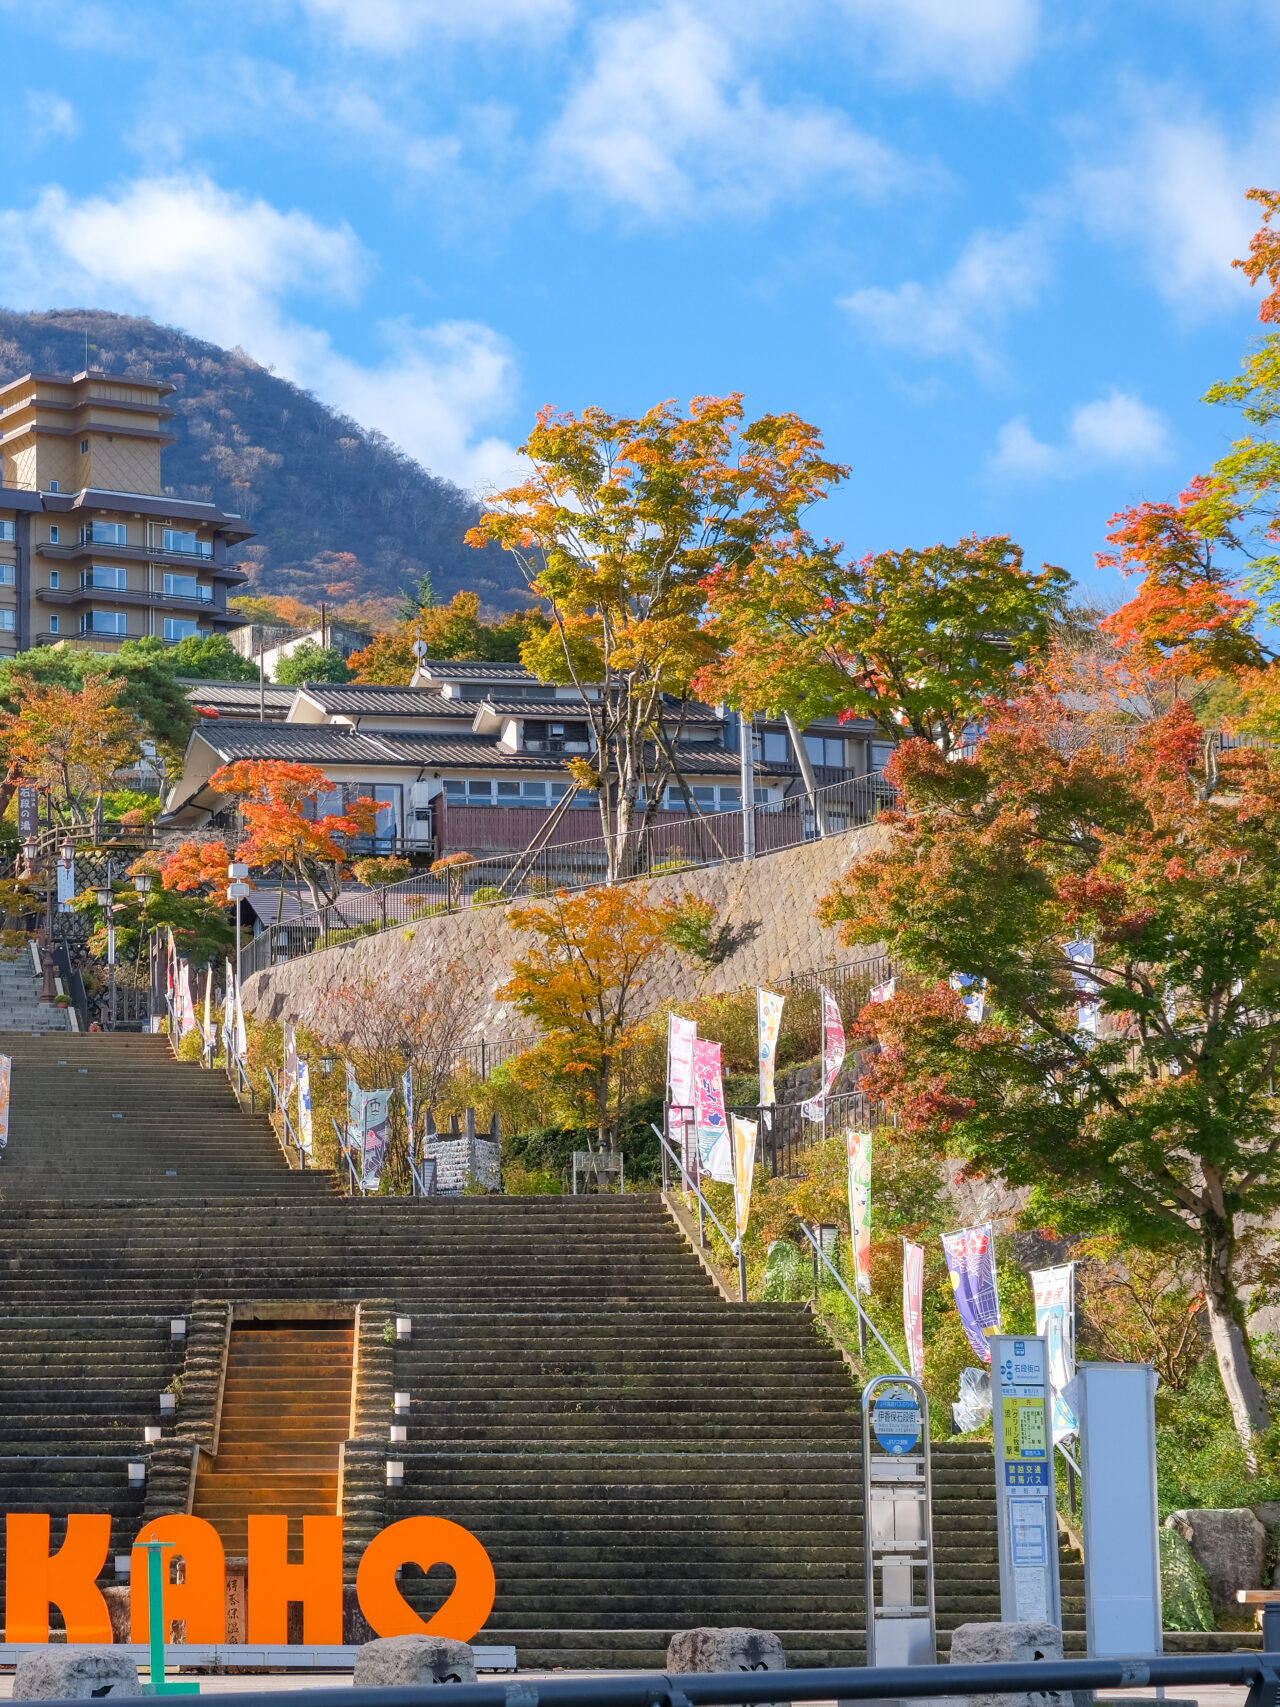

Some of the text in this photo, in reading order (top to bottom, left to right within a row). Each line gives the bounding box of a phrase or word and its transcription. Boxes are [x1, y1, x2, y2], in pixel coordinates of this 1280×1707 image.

[20, 788, 31, 831] 石段の湯
[1014, 1364, 1040, 1373] 石段街口
[878, 1410, 916, 1423] 伊香保石段街
[1005, 1409, 1013, 1455] 渋川駅
[1009, 1475, 1042, 1484] 群馬バス
